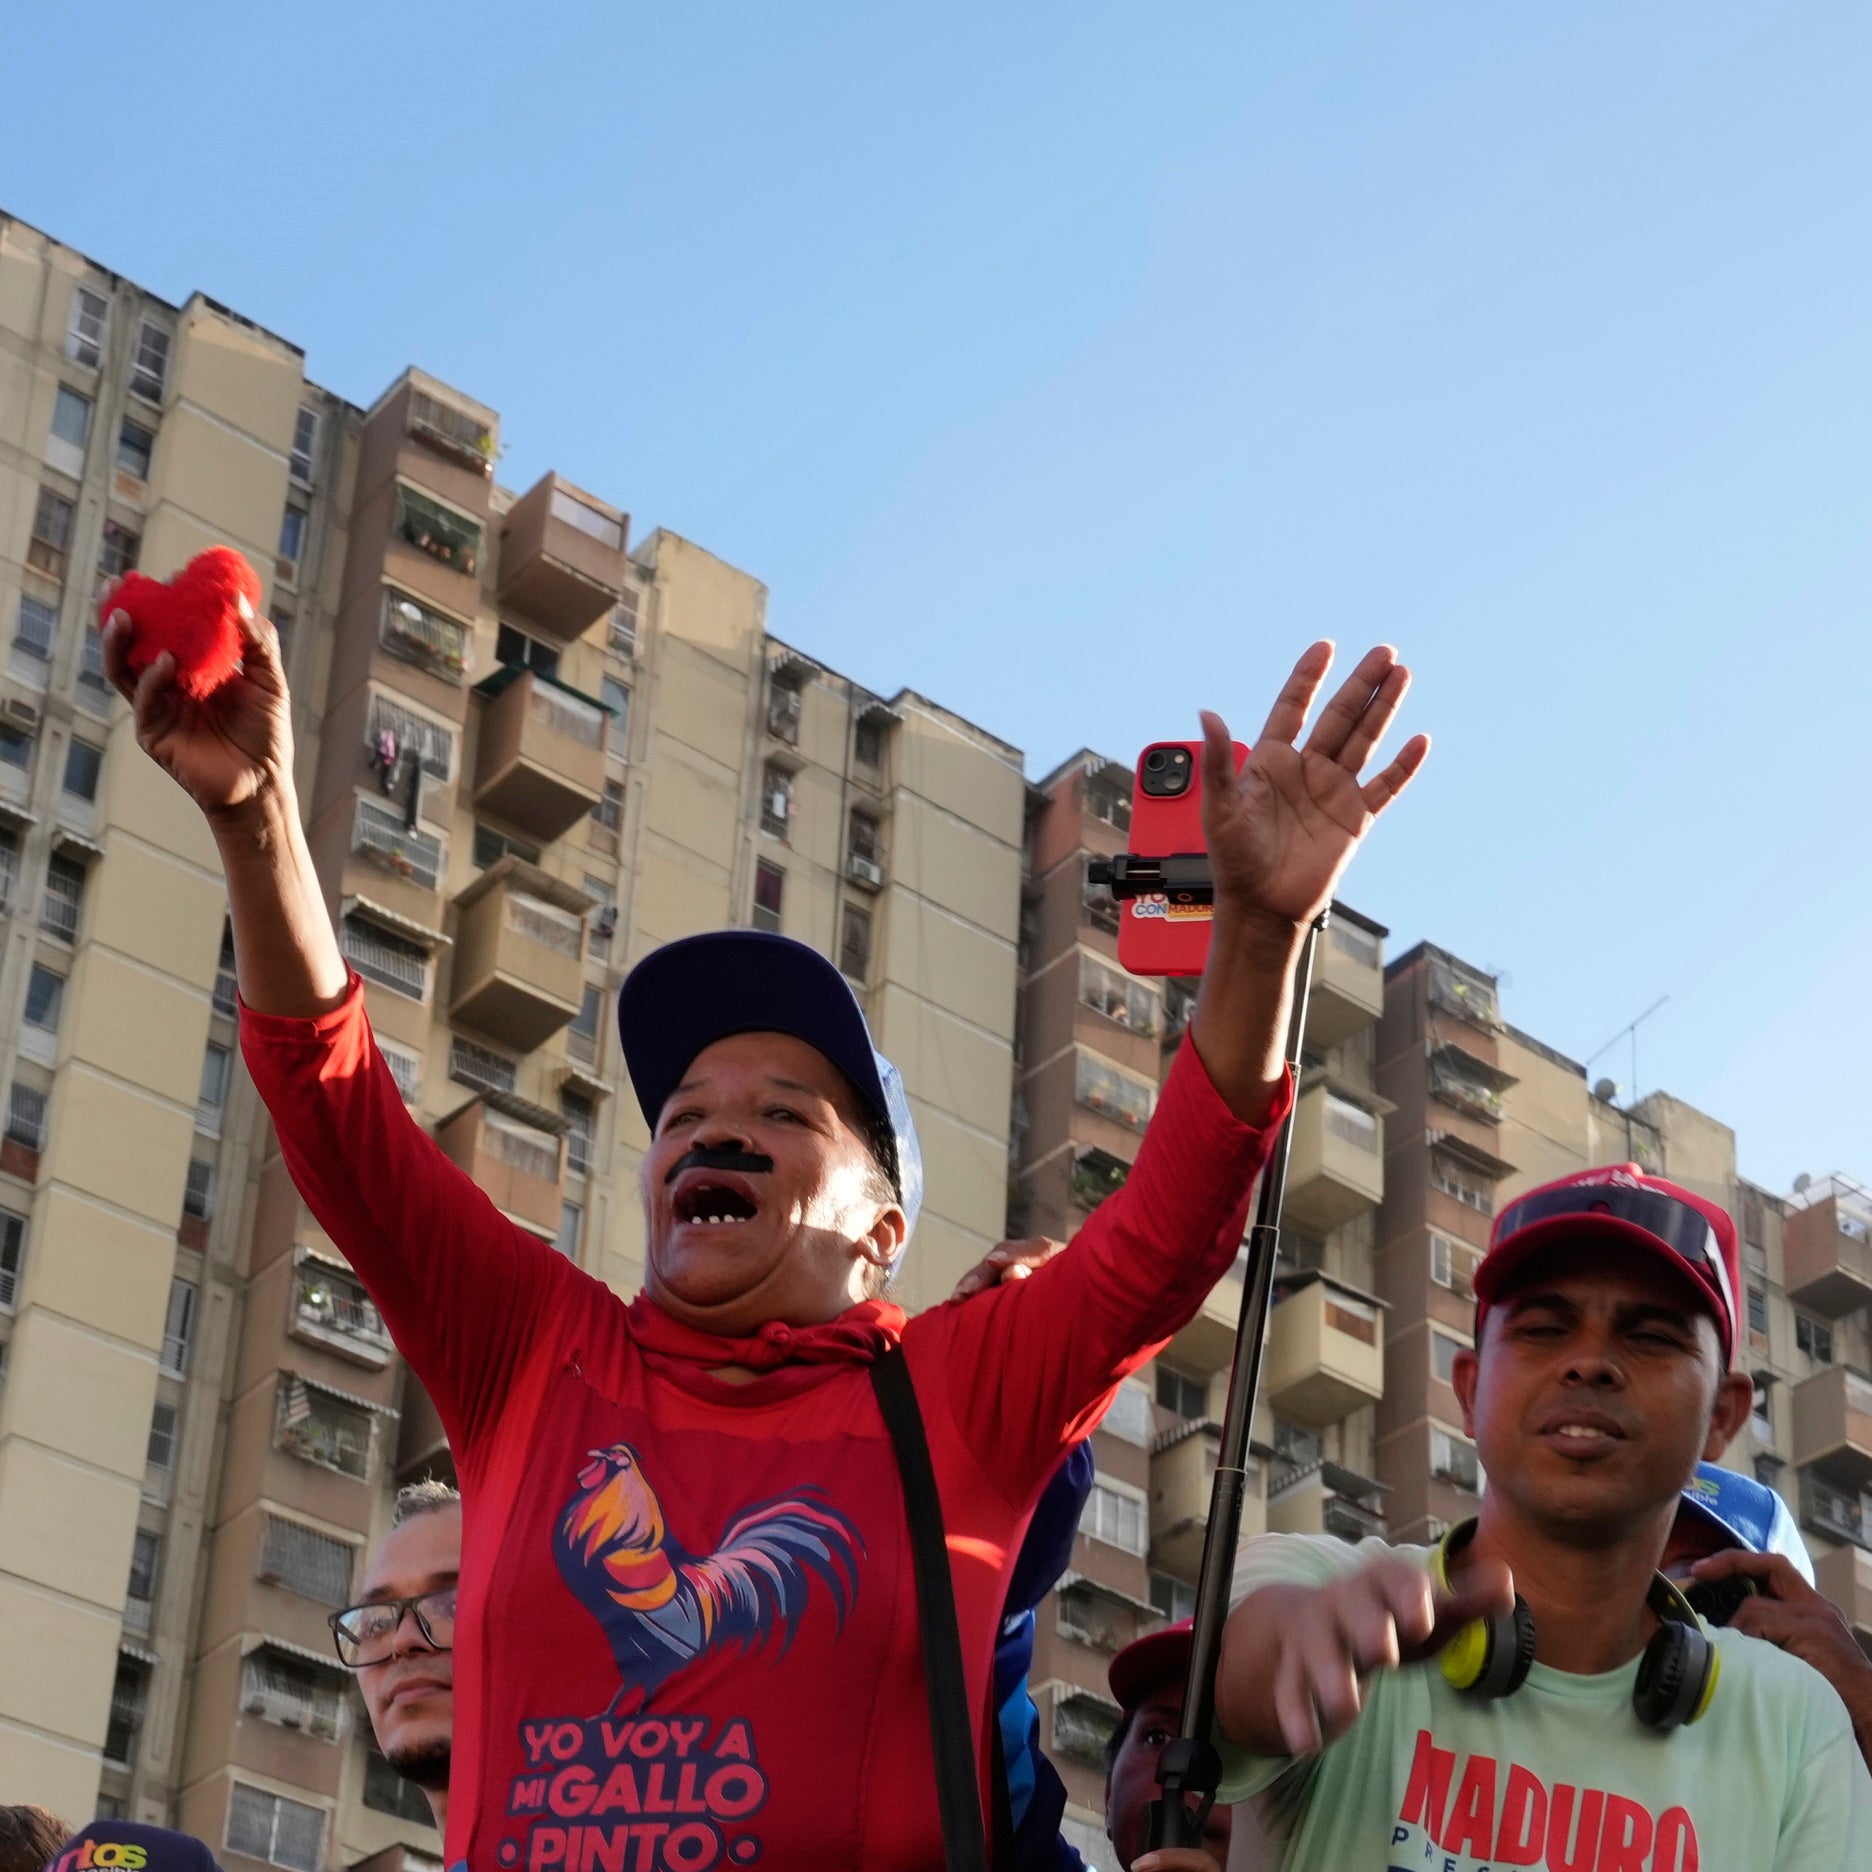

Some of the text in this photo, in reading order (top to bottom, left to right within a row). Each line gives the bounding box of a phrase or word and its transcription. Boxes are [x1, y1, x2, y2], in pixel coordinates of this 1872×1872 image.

[1135, 904, 1215, 915] CON MADUR
[523, 1719, 753, 1763] YO VOY A
[510, 1762, 766, 1820] MI GALLO
